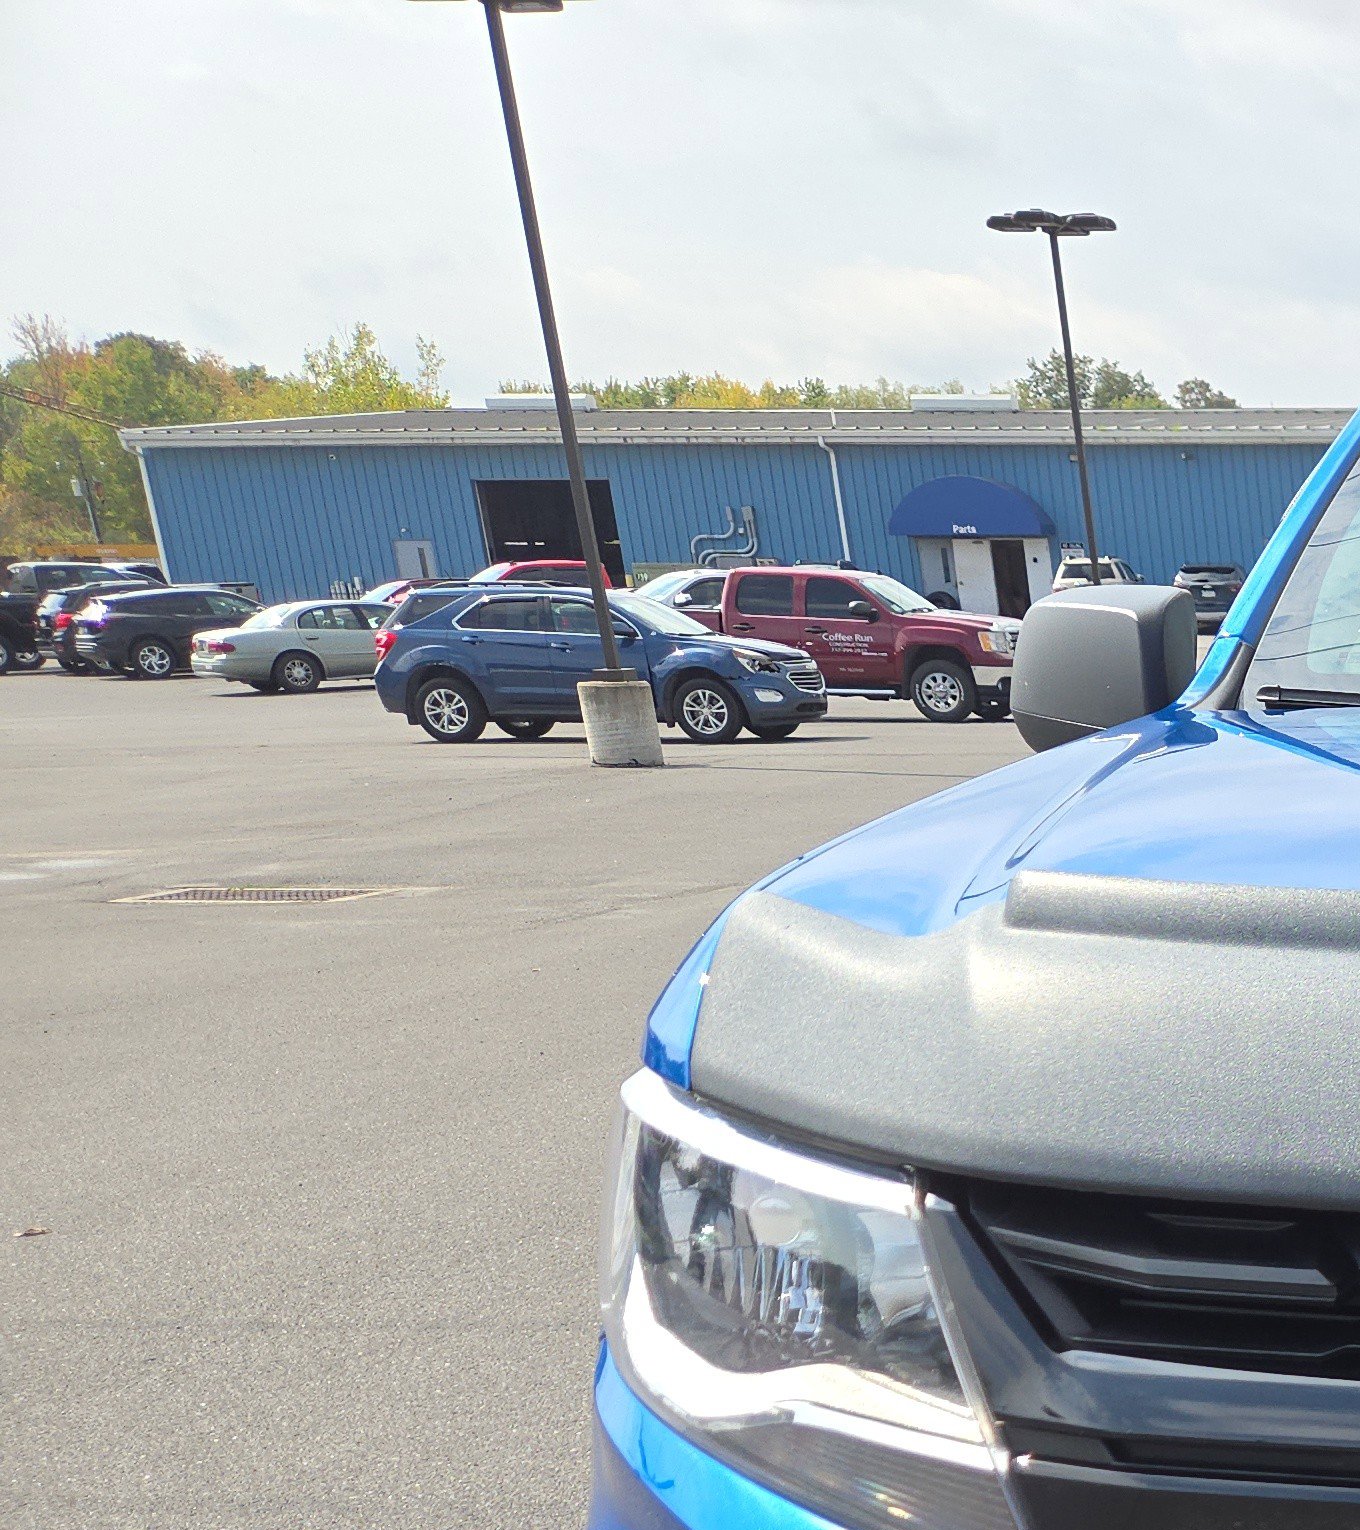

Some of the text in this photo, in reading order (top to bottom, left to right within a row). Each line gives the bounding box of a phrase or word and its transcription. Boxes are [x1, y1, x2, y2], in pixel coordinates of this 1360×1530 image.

[952, 524, 977, 534] Parts
[822, 632, 874, 642] Coffee Run
